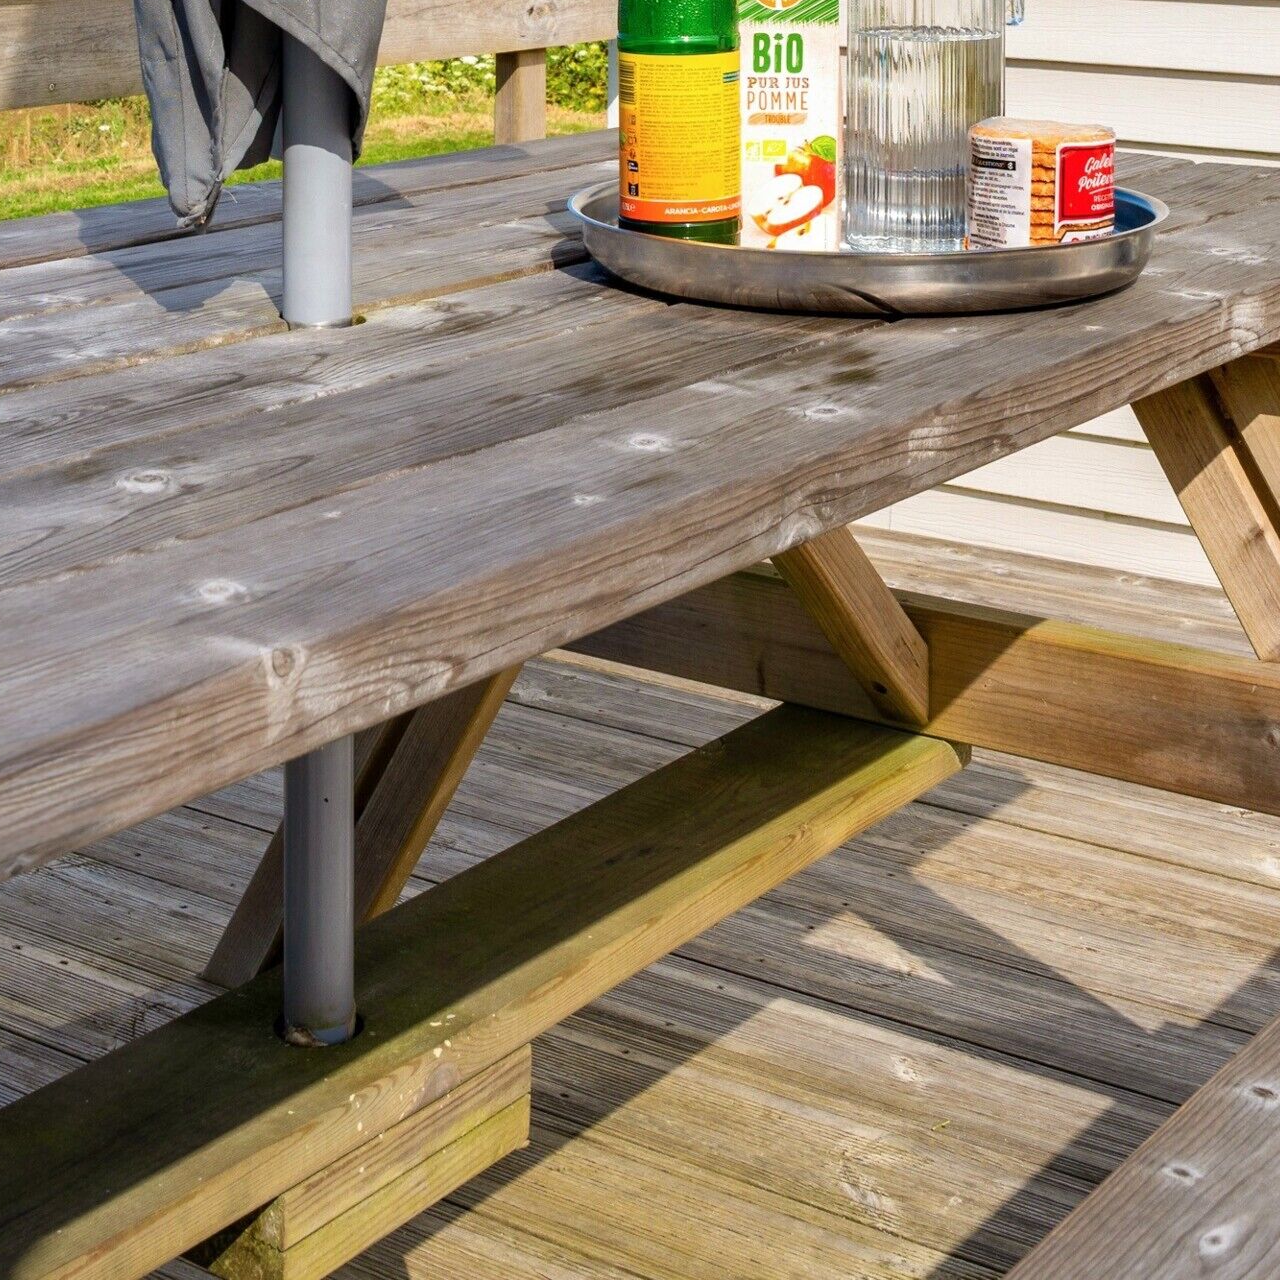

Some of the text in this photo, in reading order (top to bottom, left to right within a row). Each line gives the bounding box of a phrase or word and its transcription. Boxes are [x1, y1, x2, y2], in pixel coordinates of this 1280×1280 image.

[747, 77, 810, 89] PUR JUS
[747, 90, 809, 111] POMME
[764, 114, 792, 125] TROUBLE
